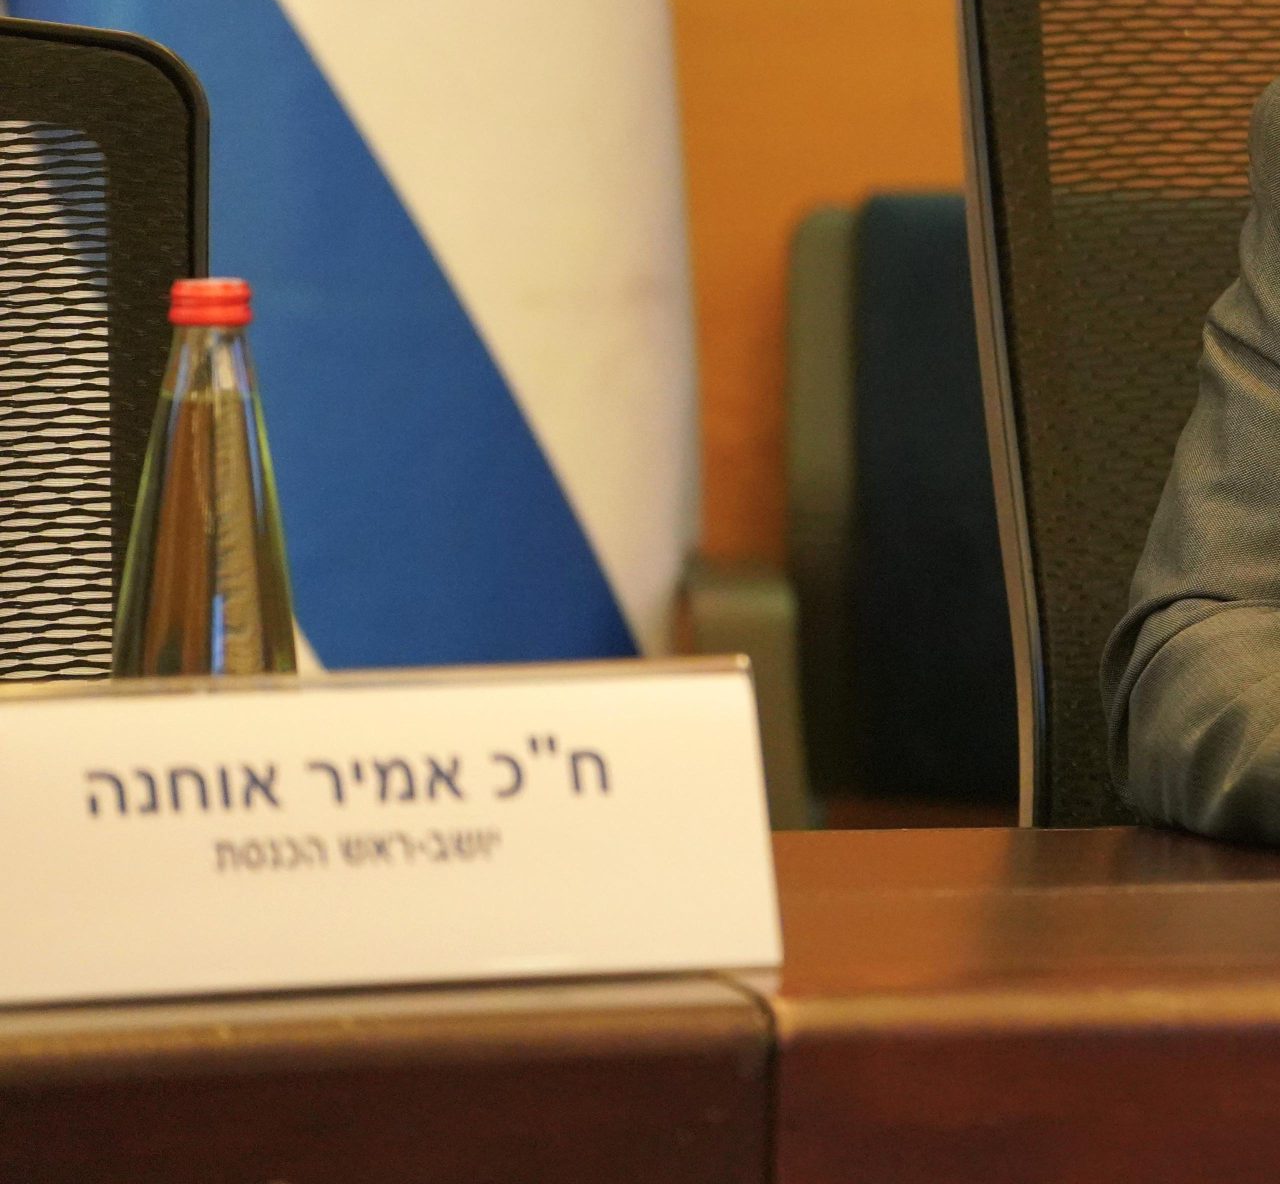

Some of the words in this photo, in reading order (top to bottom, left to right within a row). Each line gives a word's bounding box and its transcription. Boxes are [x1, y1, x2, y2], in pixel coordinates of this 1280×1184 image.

[86, 762, 282, 817] אוחנה
[308, 754, 466, 806] אמיר
[492, 733, 610, 797] ח"כ
[213, 835, 329, 873] הכנסת
